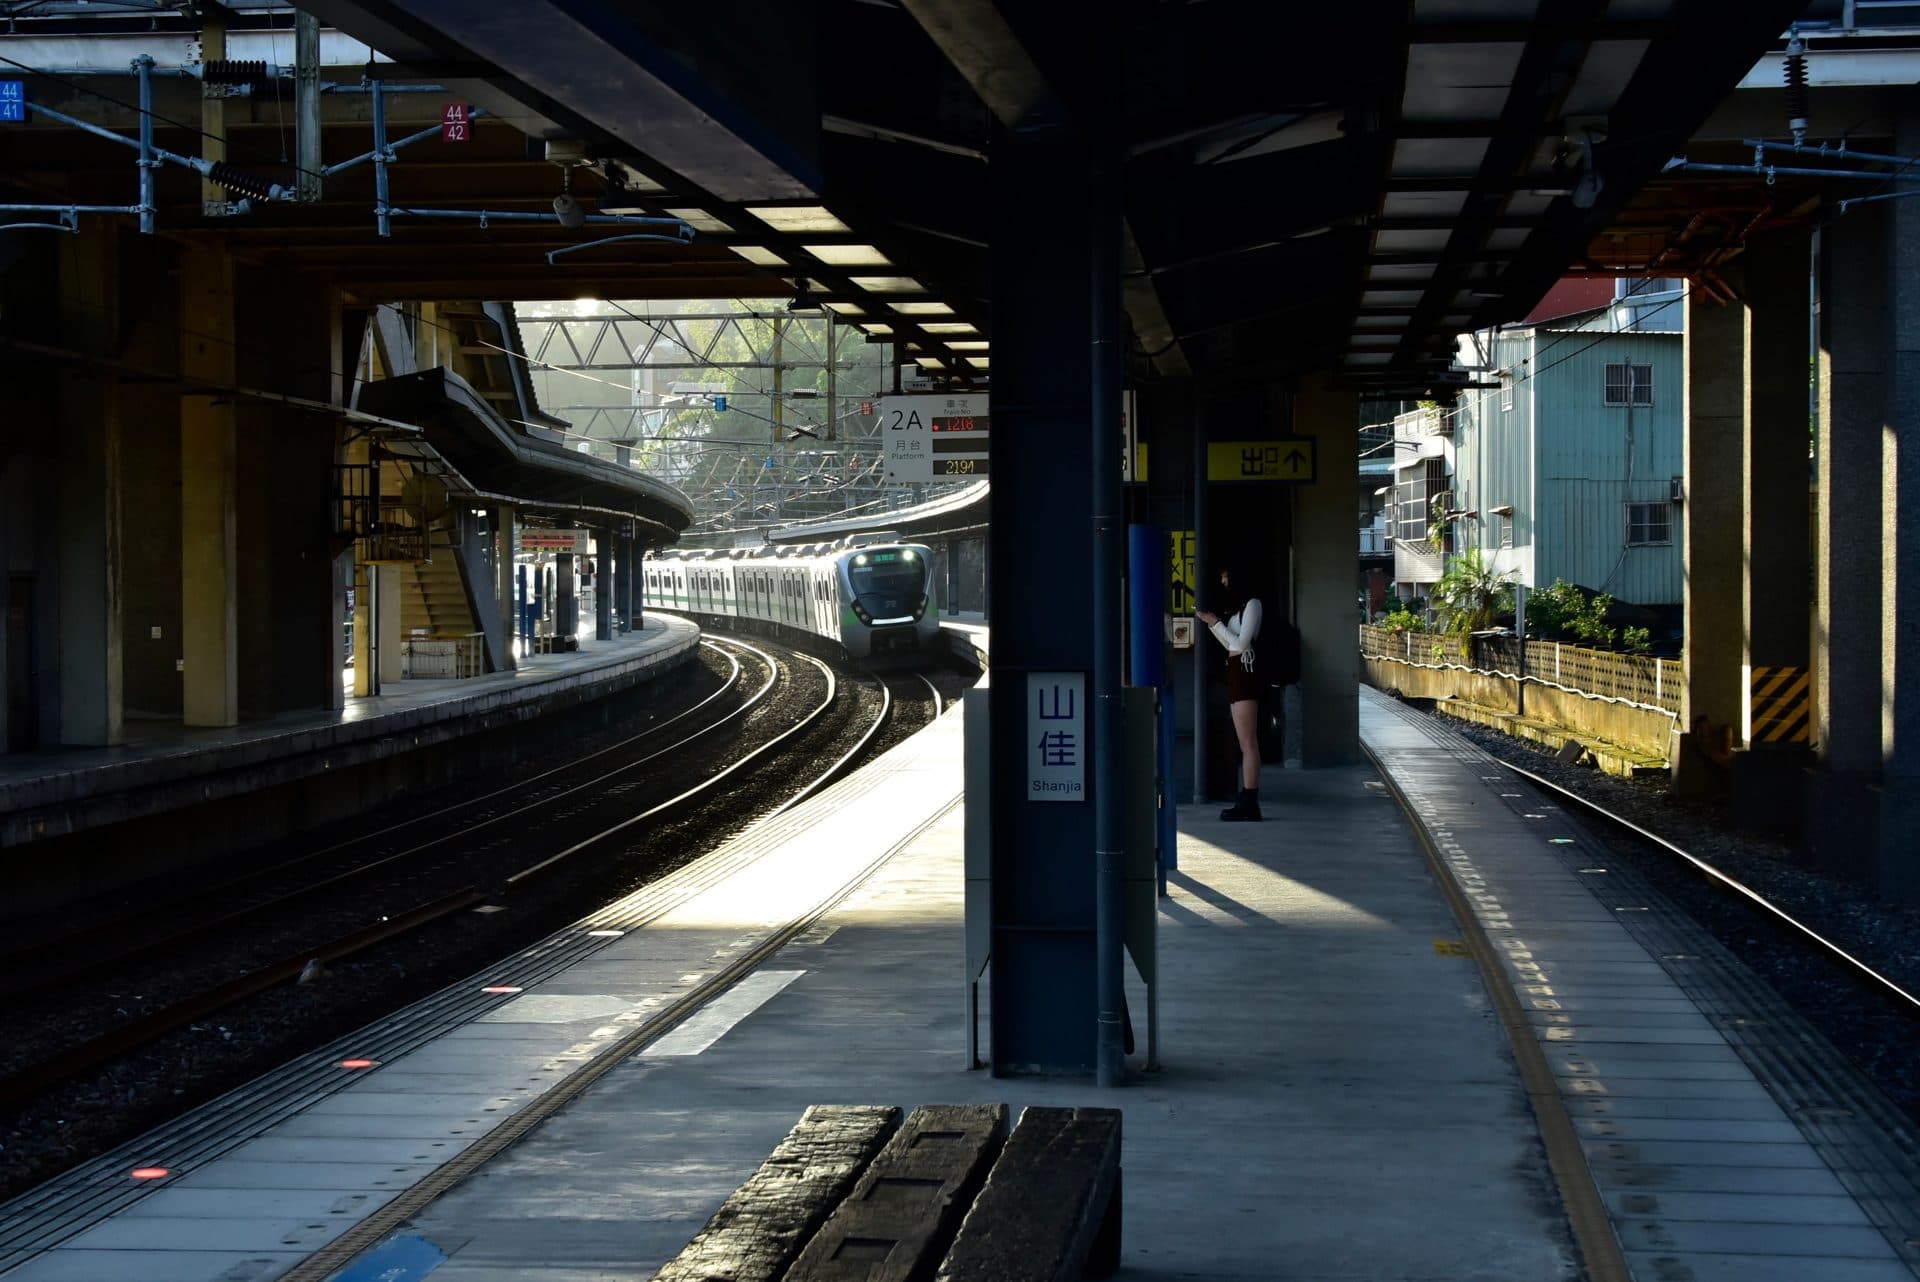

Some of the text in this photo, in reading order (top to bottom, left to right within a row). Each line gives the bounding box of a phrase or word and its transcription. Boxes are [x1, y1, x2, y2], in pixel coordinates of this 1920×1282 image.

[2, 83, 18, 98] 44
[3, 103, 18, 119] 41
[446, 105, 462, 120] 44
[447, 125, 465, 141] 42
[891, 410, 923, 431] 2A
[896, 440, 921, 451] 月台
[1241, 447, 1278, 476] 出口
[1038, 685, 1076, 767] 山佳
[1032, 780, 1081, 793] Shanjia
